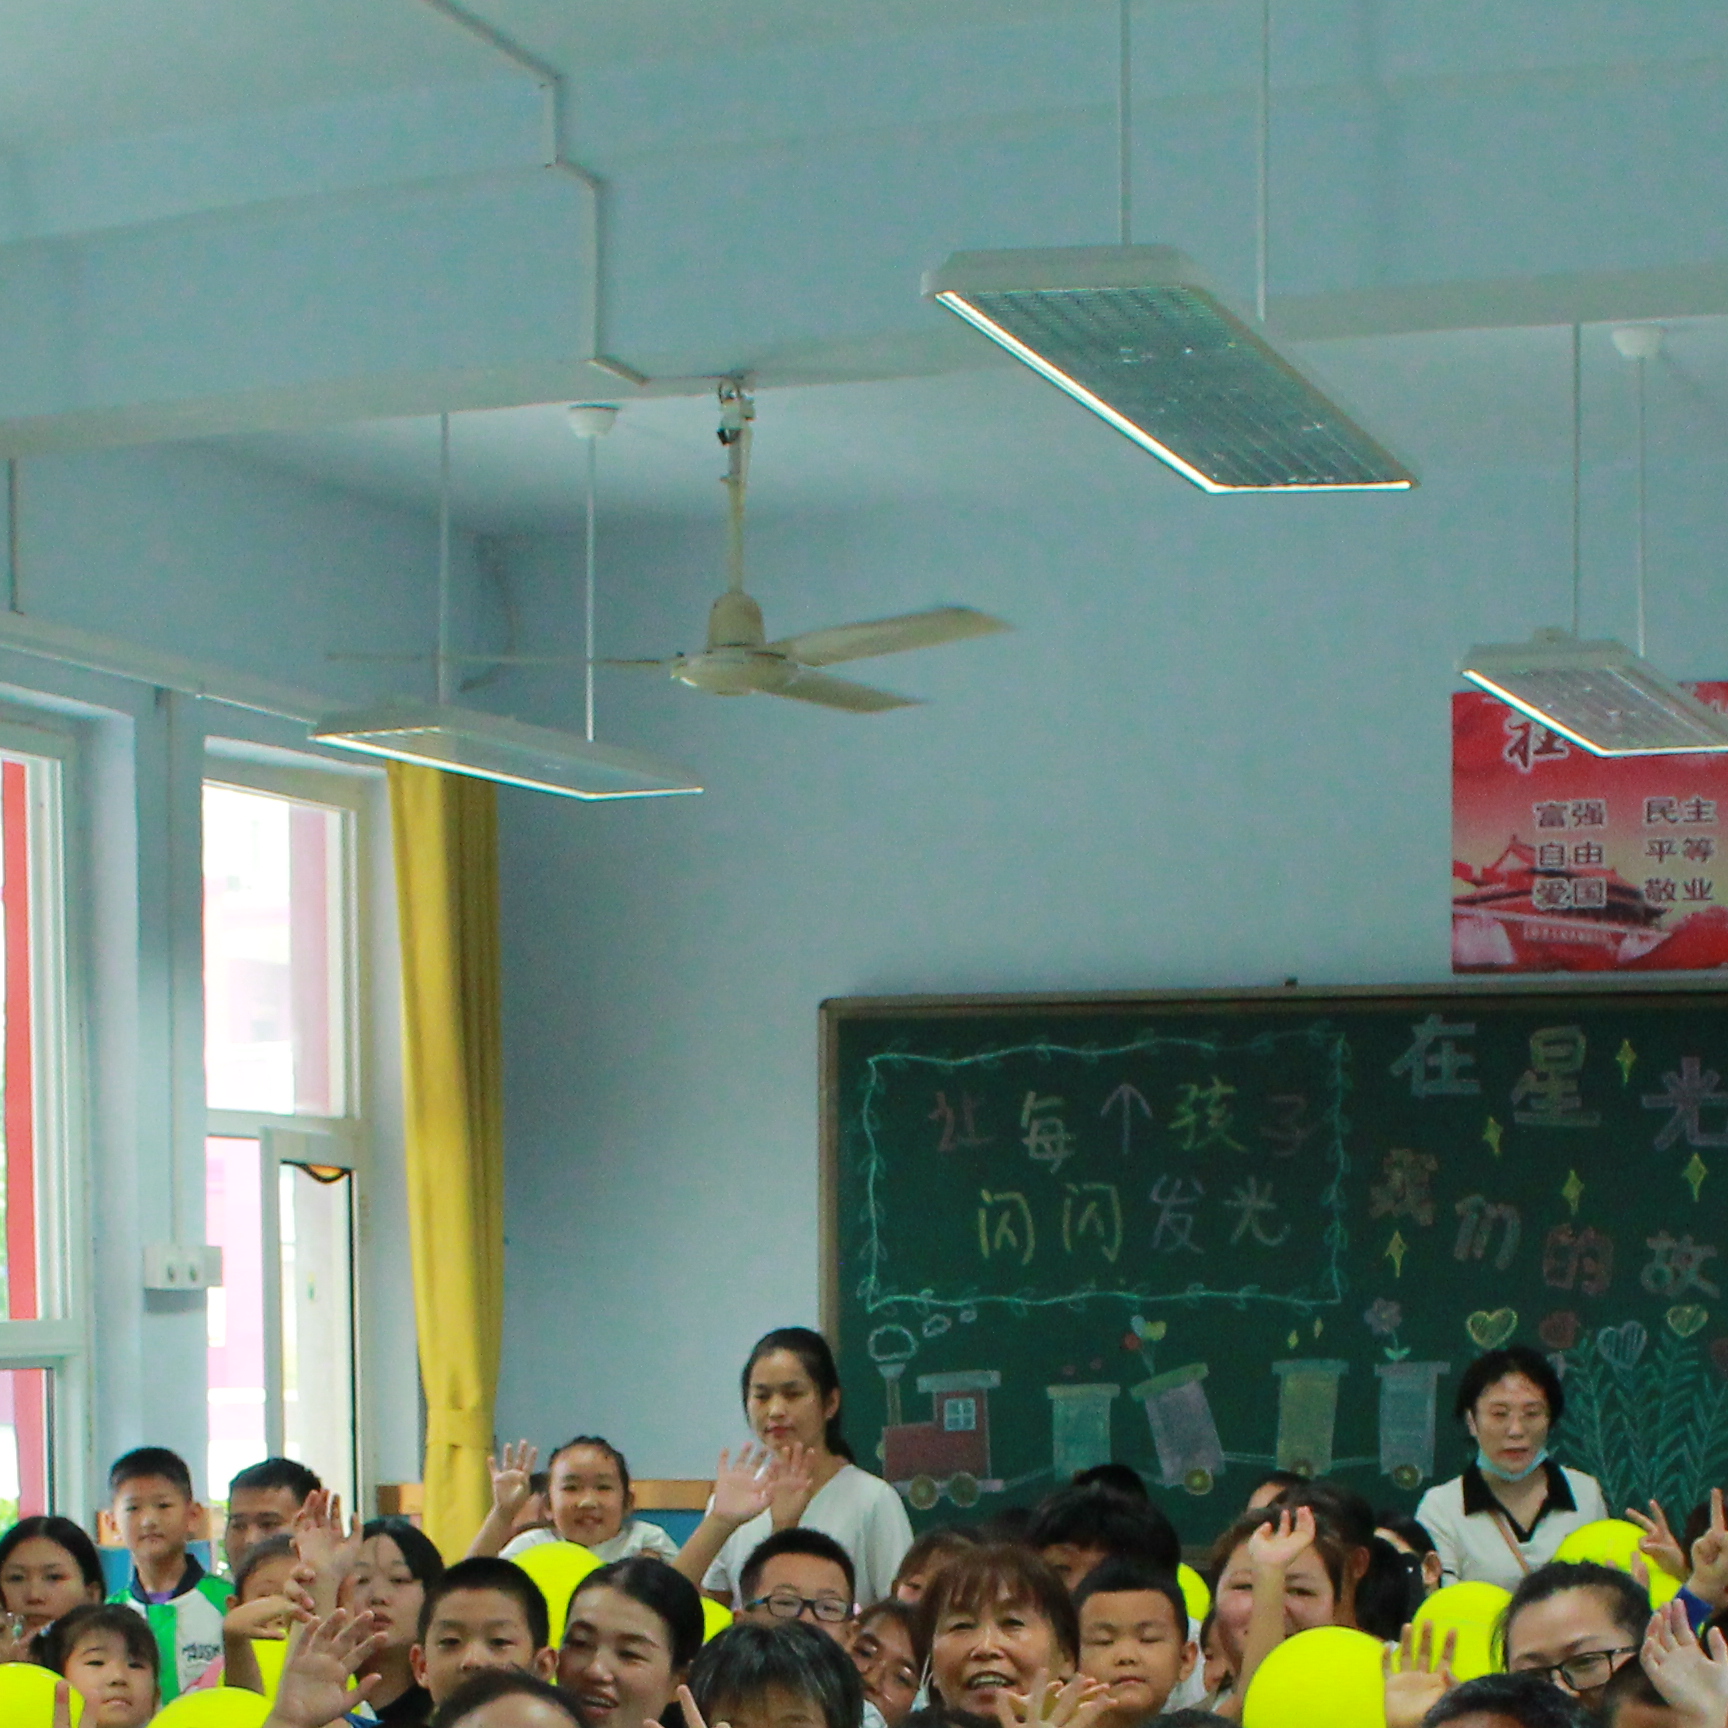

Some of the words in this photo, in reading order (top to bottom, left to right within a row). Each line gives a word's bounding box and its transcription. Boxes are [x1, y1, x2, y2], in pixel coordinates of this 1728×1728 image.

[1533, 800, 1606, 829] 富强
[1644, 797, 1716, 825] 民主
[1536, 841, 1605, 869] 自由
[1644, 837, 1716, 865] 平等
[1533, 878, 1607, 908] 爱国
[1644, 876, 1714, 904] 敬业
[928, 1076, 1319, 1173] 让每个孩子
[977, 1174, 1294, 1265] 闪闪发光
